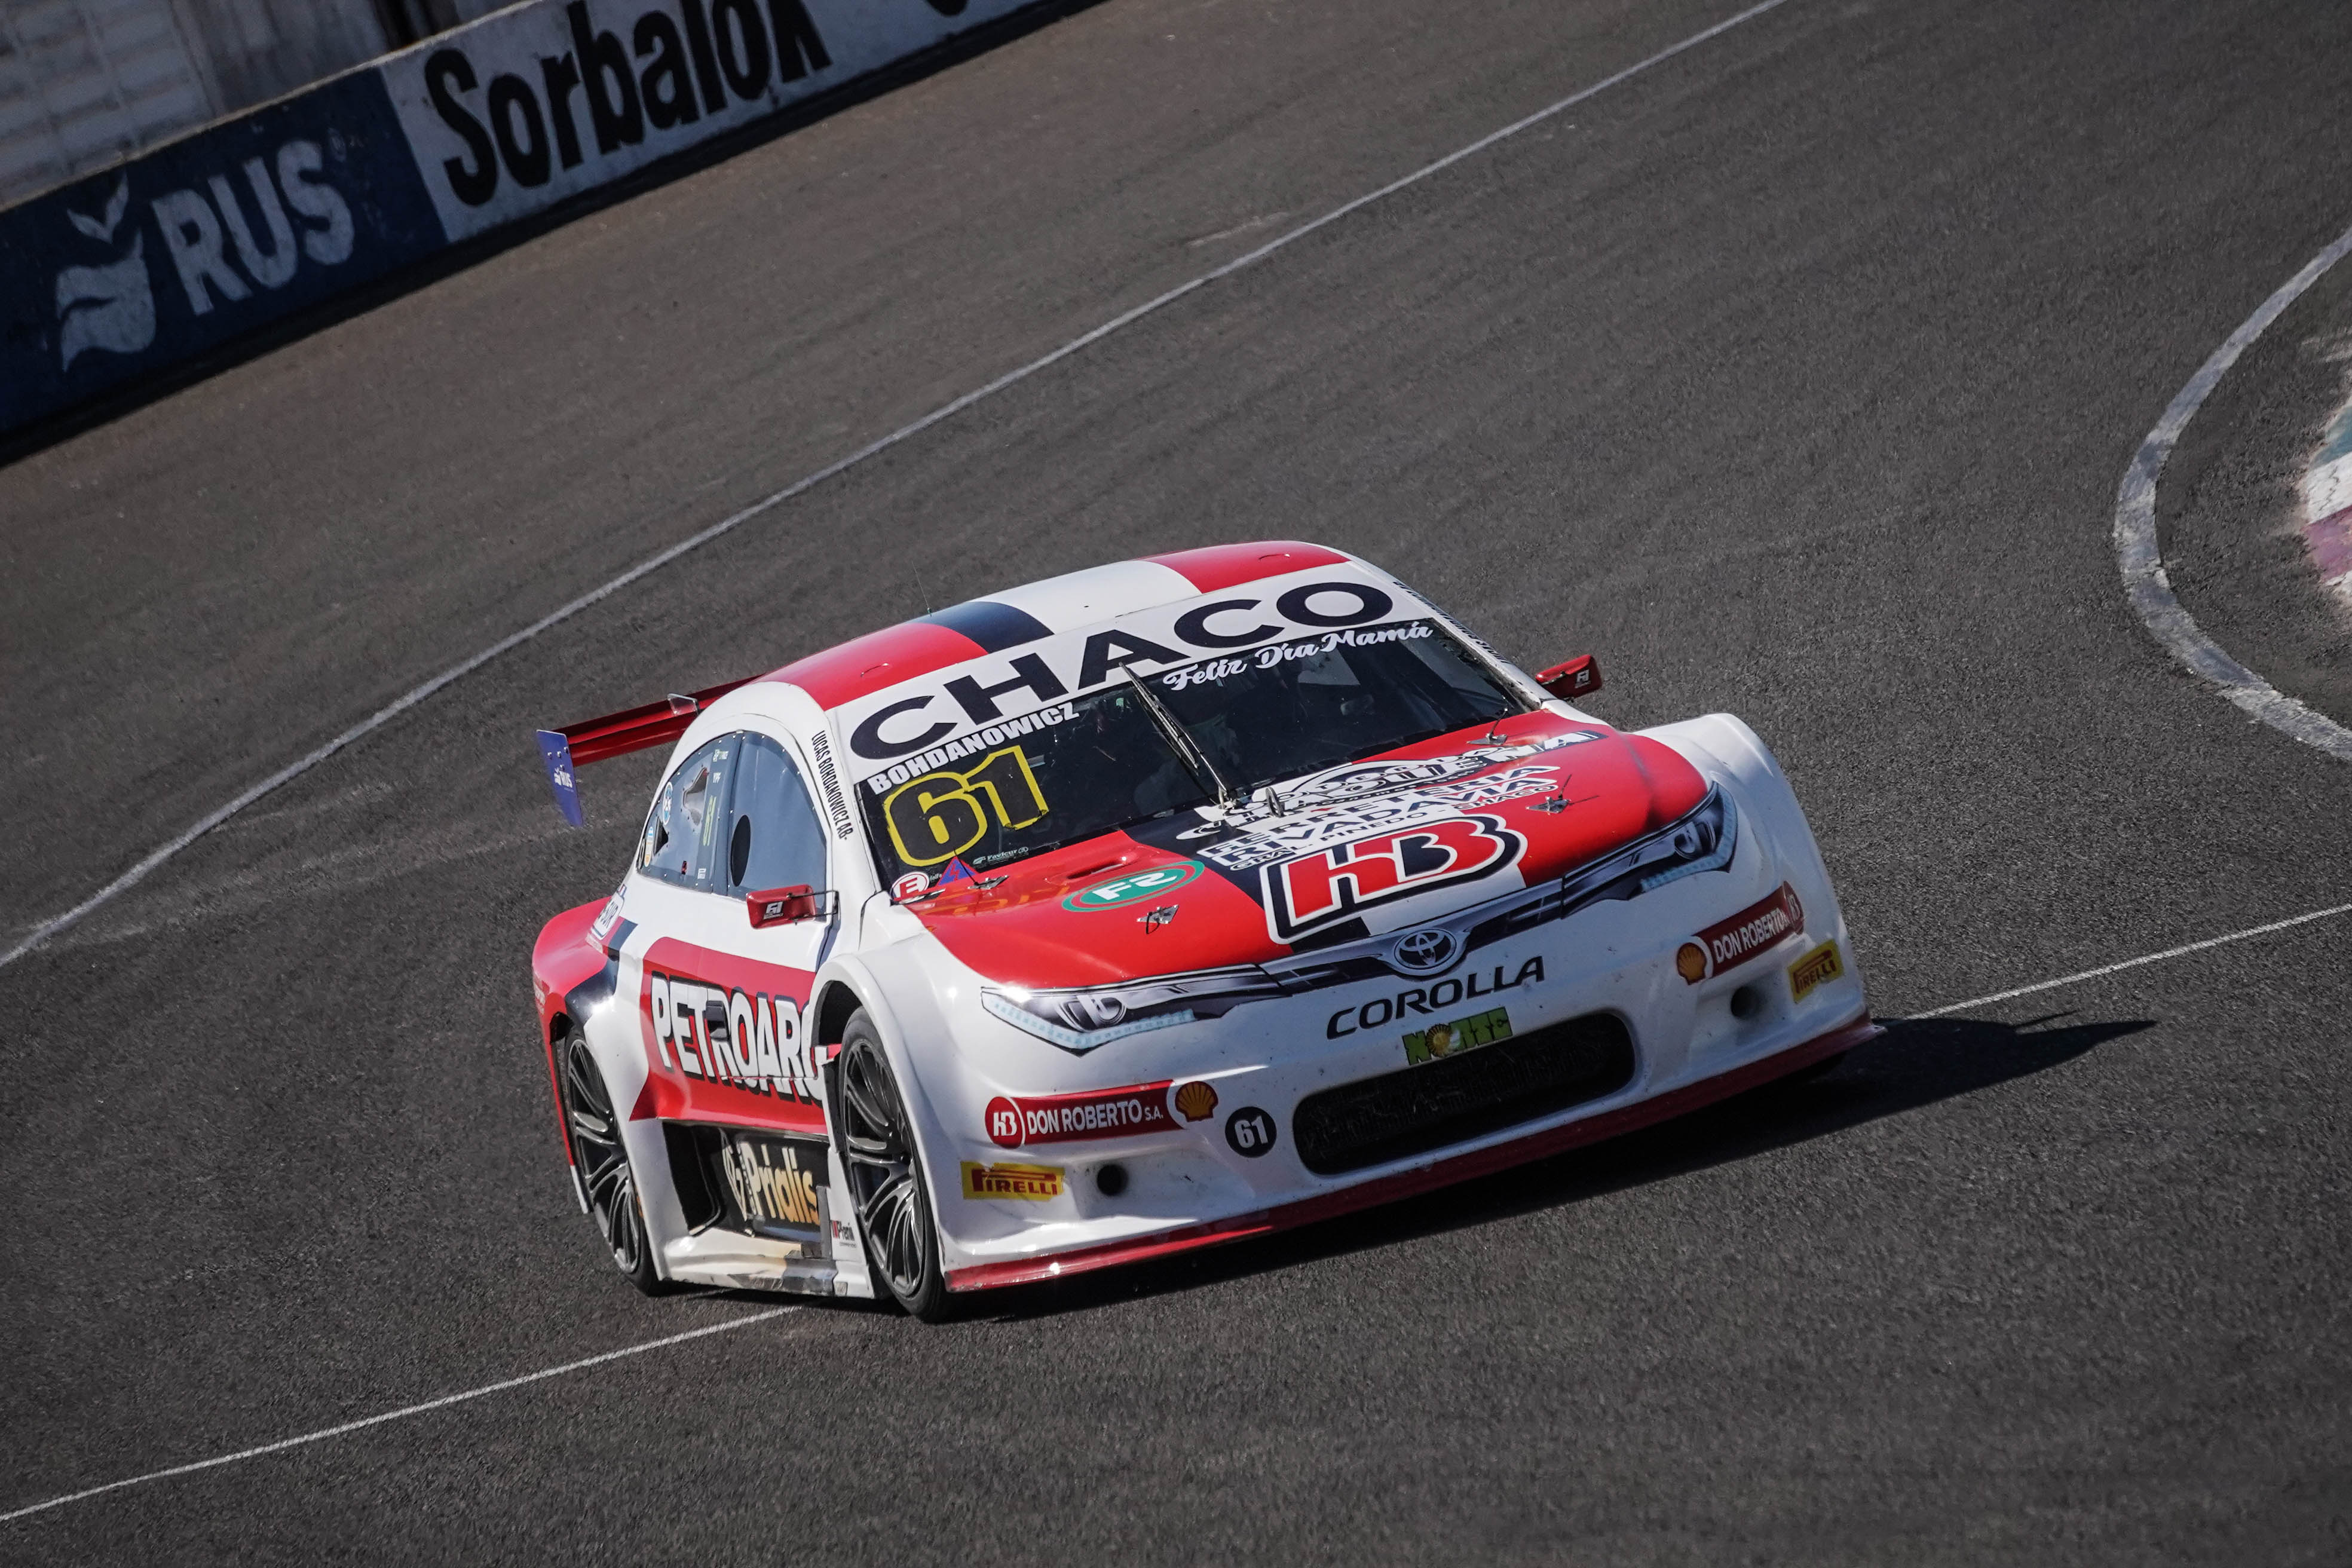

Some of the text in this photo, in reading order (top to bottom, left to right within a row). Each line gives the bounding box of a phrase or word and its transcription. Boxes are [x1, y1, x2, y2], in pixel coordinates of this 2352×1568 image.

[150, 140, 356, 316] RUS
[850, 583, 1393, 760] CHACO
[1163, 659, 1247, 691] Feliz
[1318, 621, 1434, 652] Mamá
[811, 730, 830, 761] LUCAS
[865, 702, 1079, 796] BOHDANOWICZ
[819, 757, 849, 826] BOHDANOWICZ
[884, 745, 1049, 866] 61
[1200, 767, 1557, 857] FERRETERIA
[1213, 778, 1555, 866] RIVADAVIA
[1320, 811, 1428, 841] PINEDO
[1454, 785, 1558, 811] CHACO
[1713, 930, 1742, 964] DON
[1740, 907, 1784, 951] ROBERTO
[1327, 956, 1545, 1040] COROLLA
[1794, 950, 1837, 994] PIRELLI
[1026, 1099, 1164, 1135] DON ROBERTO S.A.
[1234, 1114, 1270, 1148] 61
[972, 1169, 1058, 1195] PIRELLI
